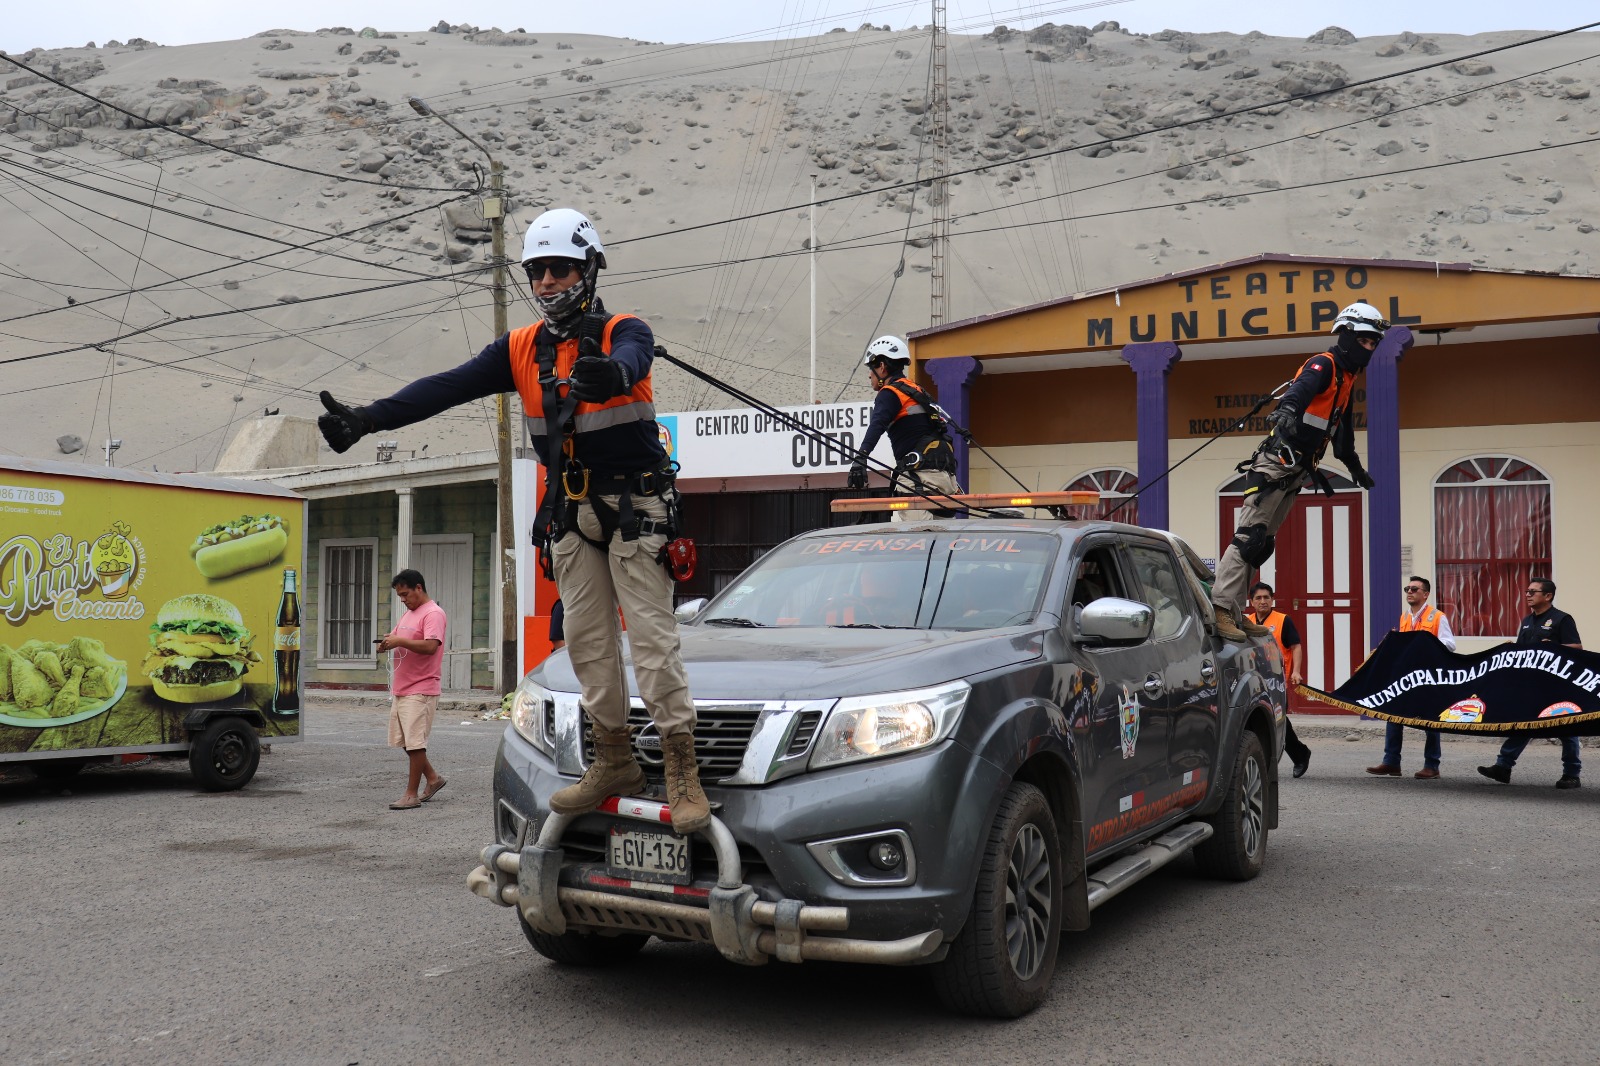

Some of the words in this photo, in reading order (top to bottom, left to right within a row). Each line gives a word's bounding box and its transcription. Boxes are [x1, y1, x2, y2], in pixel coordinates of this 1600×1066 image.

[1178, 267, 1368, 303] TEATRO
[1087, 296, 1421, 346] MUNICIPL
[696, 414, 749, 437] CENTRO
[754, 407, 854, 434] OPERACIONES
[792, 431, 854, 468] COED
[0, 488, 13, 499] 86
[17, 490, 34, 501] 778
[38, 491, 55, 502] 035
[44, 533, 73, 566] El
[800, 538, 926, 555] DEFENSA
[949, 538, 1022, 553] CIVIL
[50, 588, 145, 622] Crocante
[1356, 661, 1488, 709] MUNICIPALIDAD
[1489, 649, 1574, 680] DISTRITAL
[637, 739, 661, 747] NISS
[614, 839, 687, 872] EGV-136
